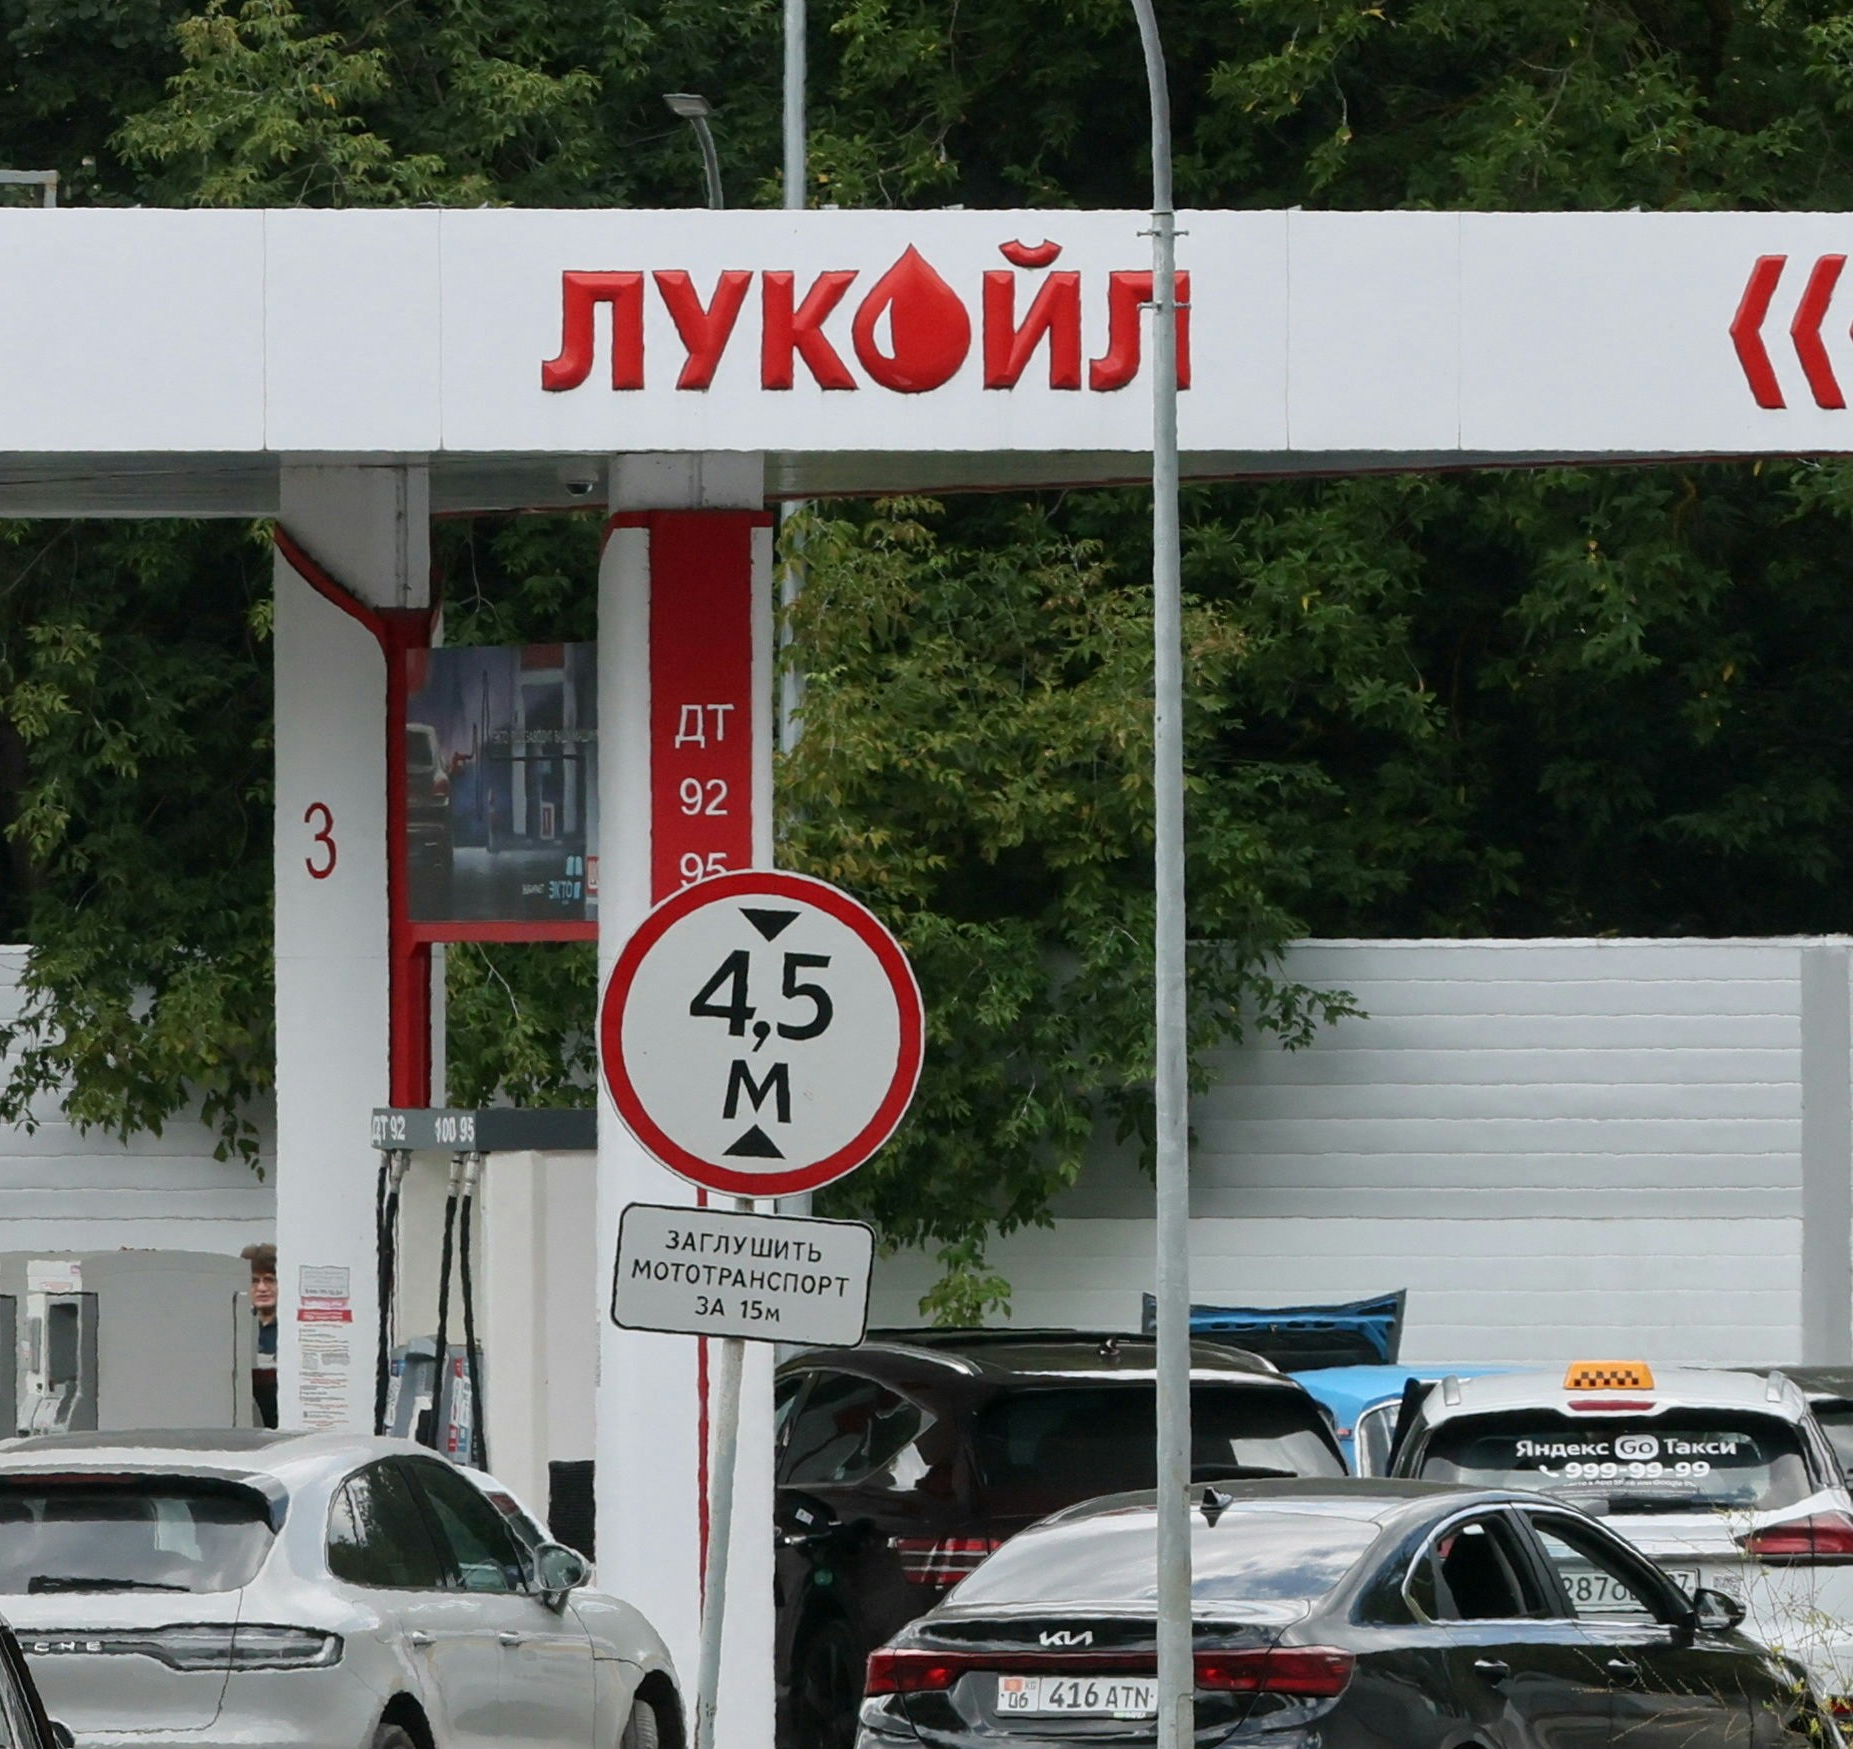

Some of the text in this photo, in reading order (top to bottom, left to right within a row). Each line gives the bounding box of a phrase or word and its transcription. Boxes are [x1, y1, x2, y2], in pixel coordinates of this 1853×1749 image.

[541, 238, 1191, 394] ЛУКОЙЛ
[674, 703, 734, 749] ДТ
[679, 777, 729, 816] 92
[304, 801, 337, 879] 3
[689, 949, 833, 1052] 4,5
[723, 1059, 791, 1124] М
[373, 1115, 475, 1146] ДТ 92 100 95
[665, 1229, 823, 1263] ЗАГЛУШИТЬ
[630, 1258, 851, 1298] МОТОТРАНСПОРТ
[694, 1295, 726, 1317] ЗА
[1515, 1434, 1738, 1459] Яндекс Go Такси
[1564, 1461, 1711, 1479] 999-99-99
[1039, 1630, 1093, 1646] KIA
[1008, 1692, 1029, 1709] 06
[1024, 1681, 1037, 1691] KG
